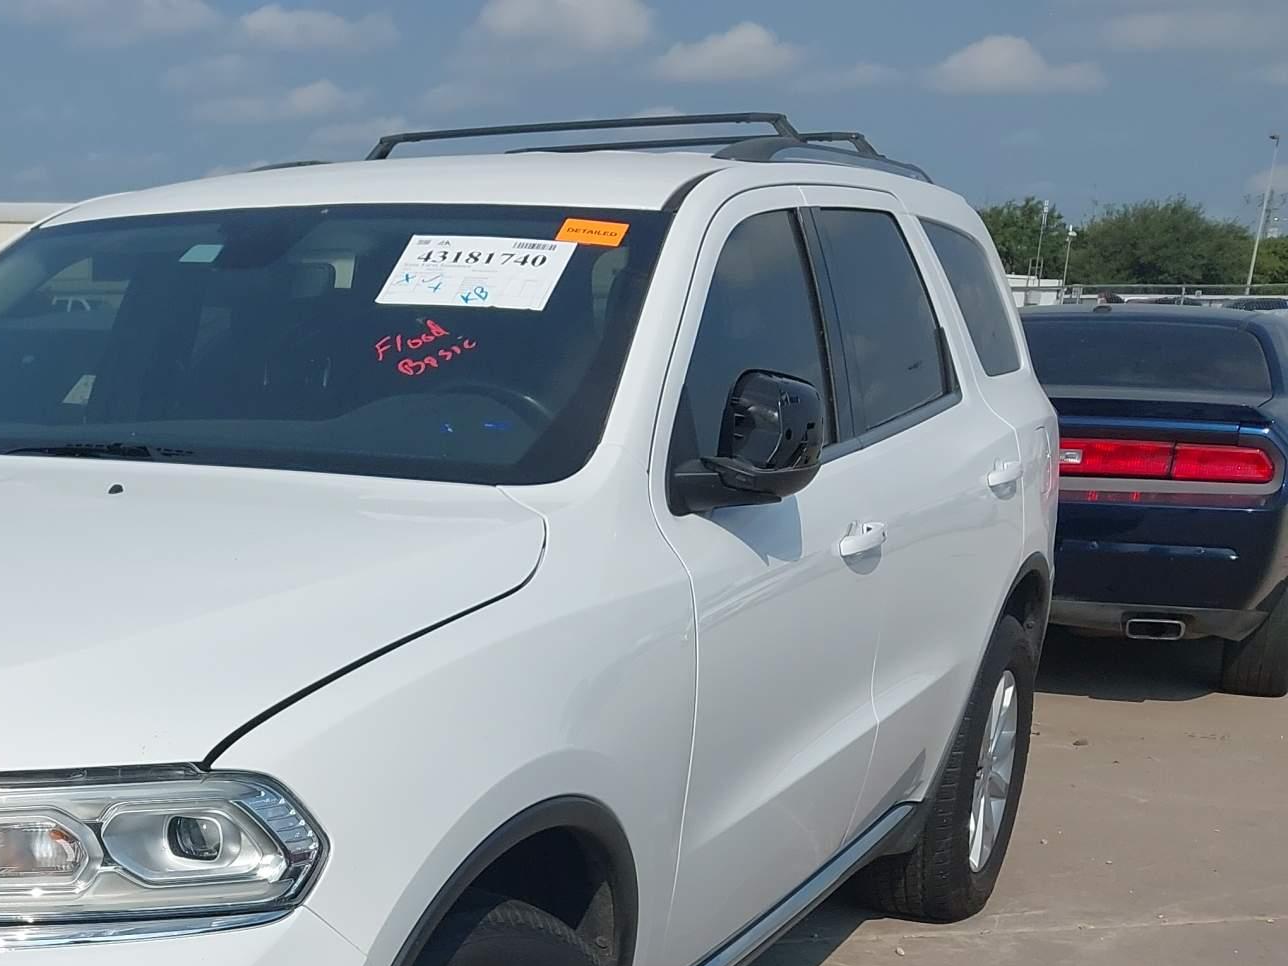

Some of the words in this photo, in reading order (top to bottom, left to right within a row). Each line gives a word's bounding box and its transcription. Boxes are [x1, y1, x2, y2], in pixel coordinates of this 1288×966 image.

[567, 226, 618, 238] DETAILED
[417, 249, 548, 268] 43181740
[375, 319, 450, 361] Flood
